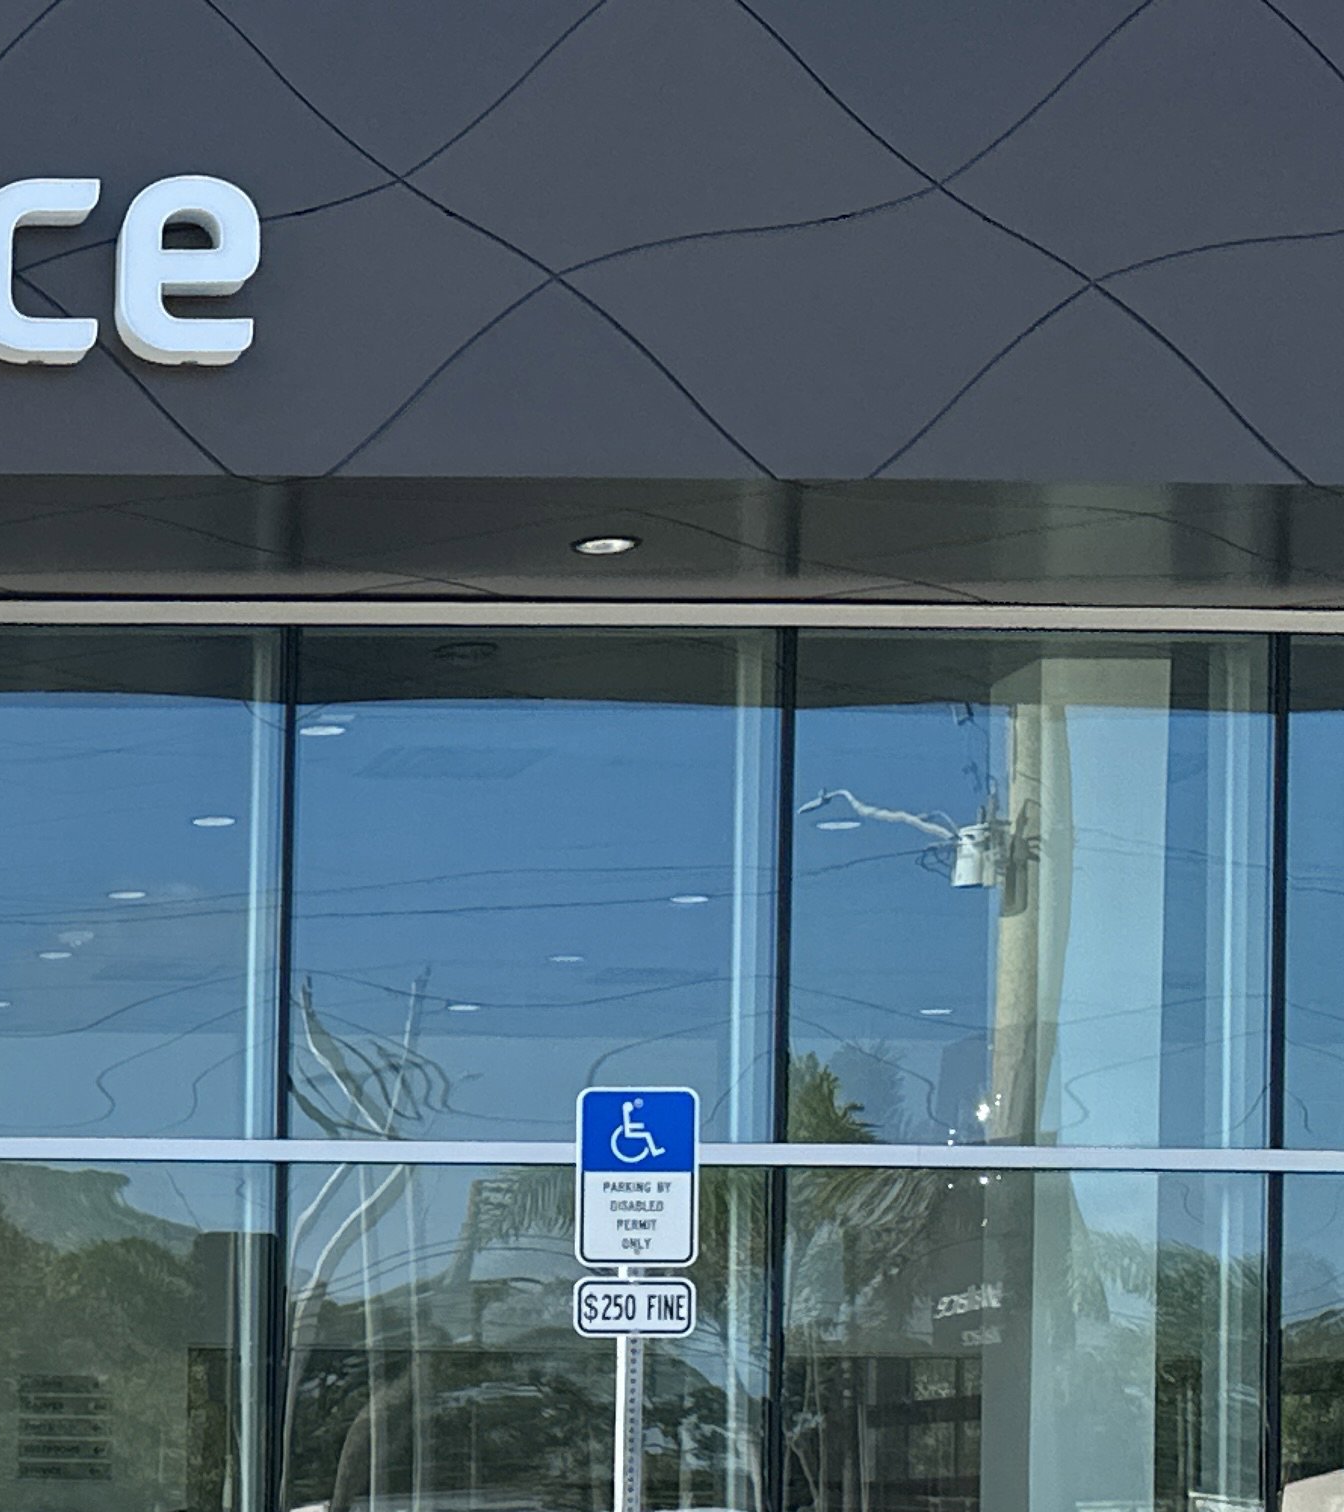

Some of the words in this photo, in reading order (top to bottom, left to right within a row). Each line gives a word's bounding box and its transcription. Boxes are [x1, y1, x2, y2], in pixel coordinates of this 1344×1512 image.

[603, 1182, 651, 1193] PARKING
[657, 1182, 672, 1193] BY
[610, 1200, 664, 1212] DISABLED
[616, 1219, 656, 1231] PERMIT
[622, 1238, 652, 1250] ONLY
[584, 1293, 637, 1323] $250
[647, 1293, 686, 1321] FINE
